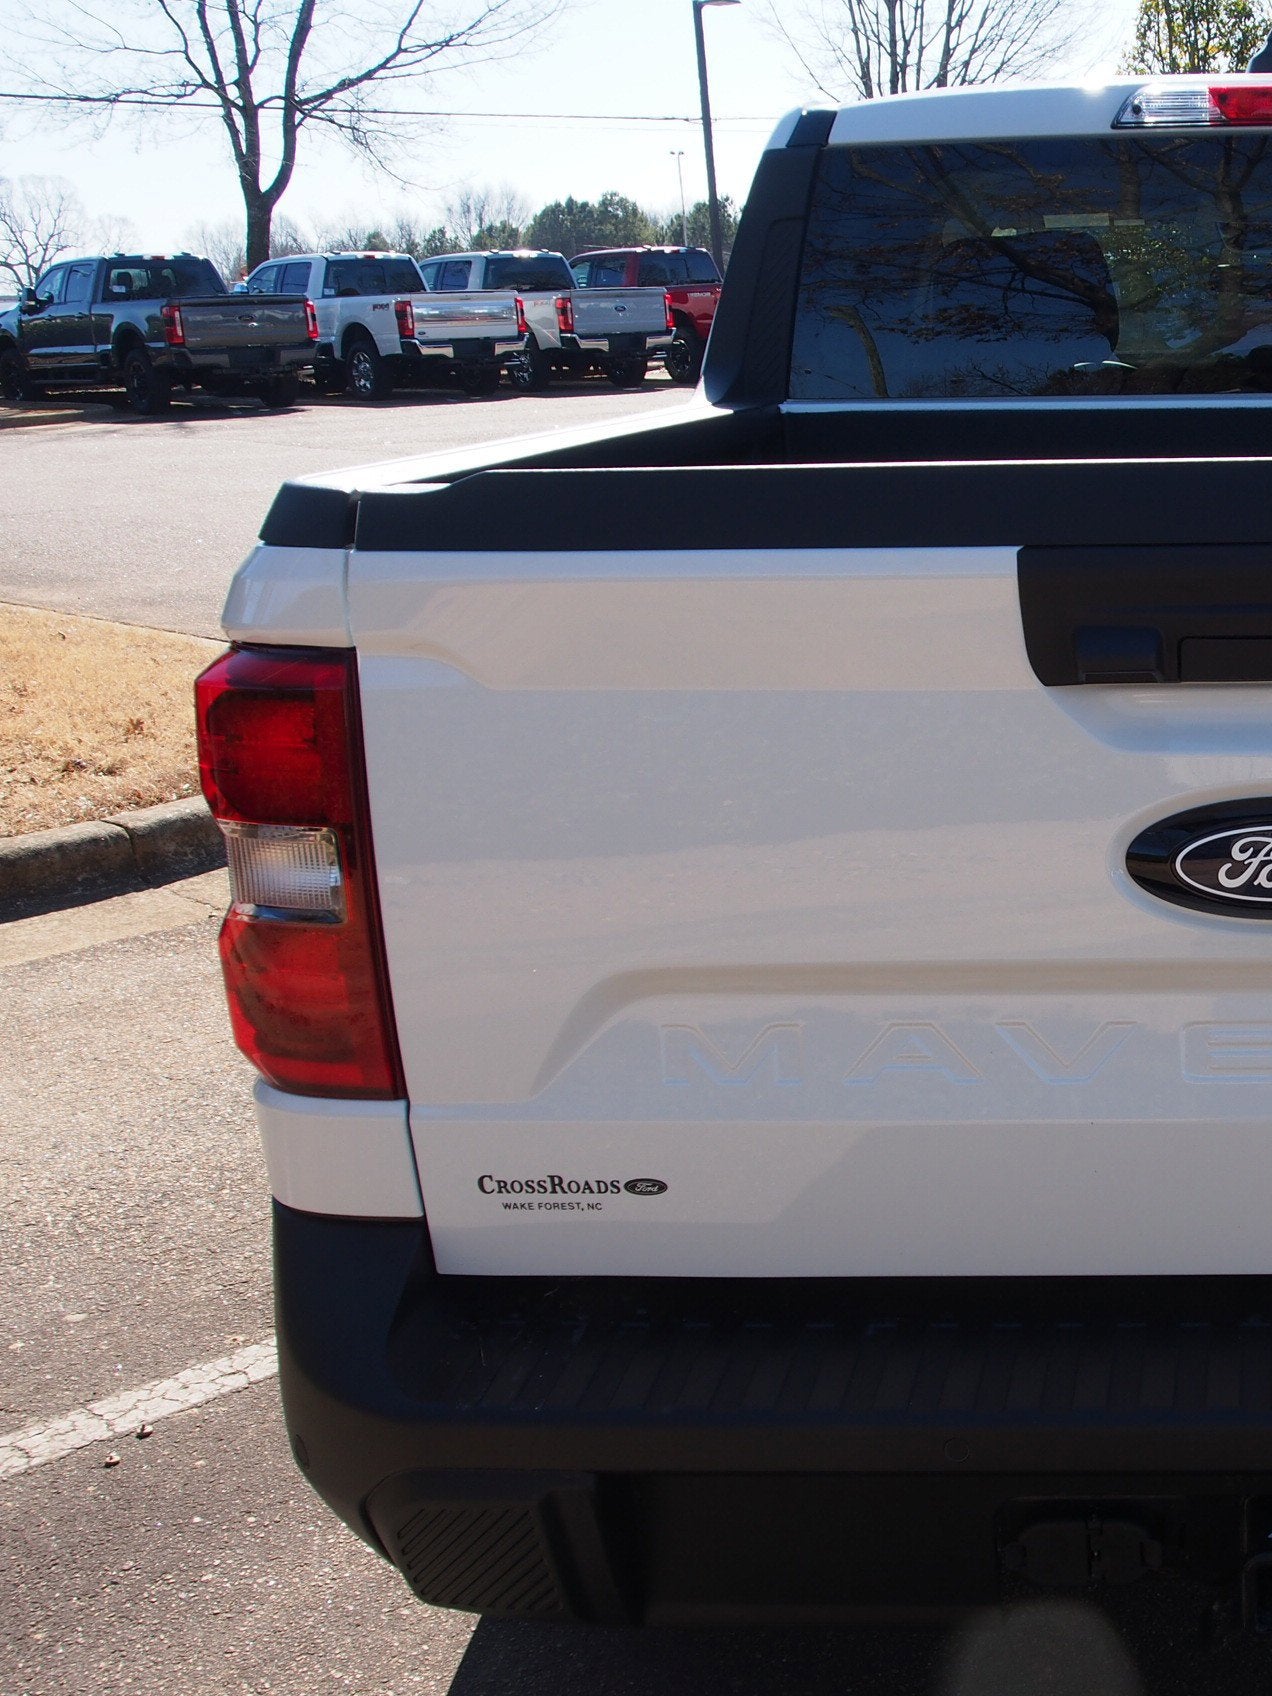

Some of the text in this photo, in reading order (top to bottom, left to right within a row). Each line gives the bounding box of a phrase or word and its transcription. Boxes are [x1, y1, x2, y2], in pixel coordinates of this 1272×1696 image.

[502, 1202, 603, 1212] WAKE FOREST, NC
